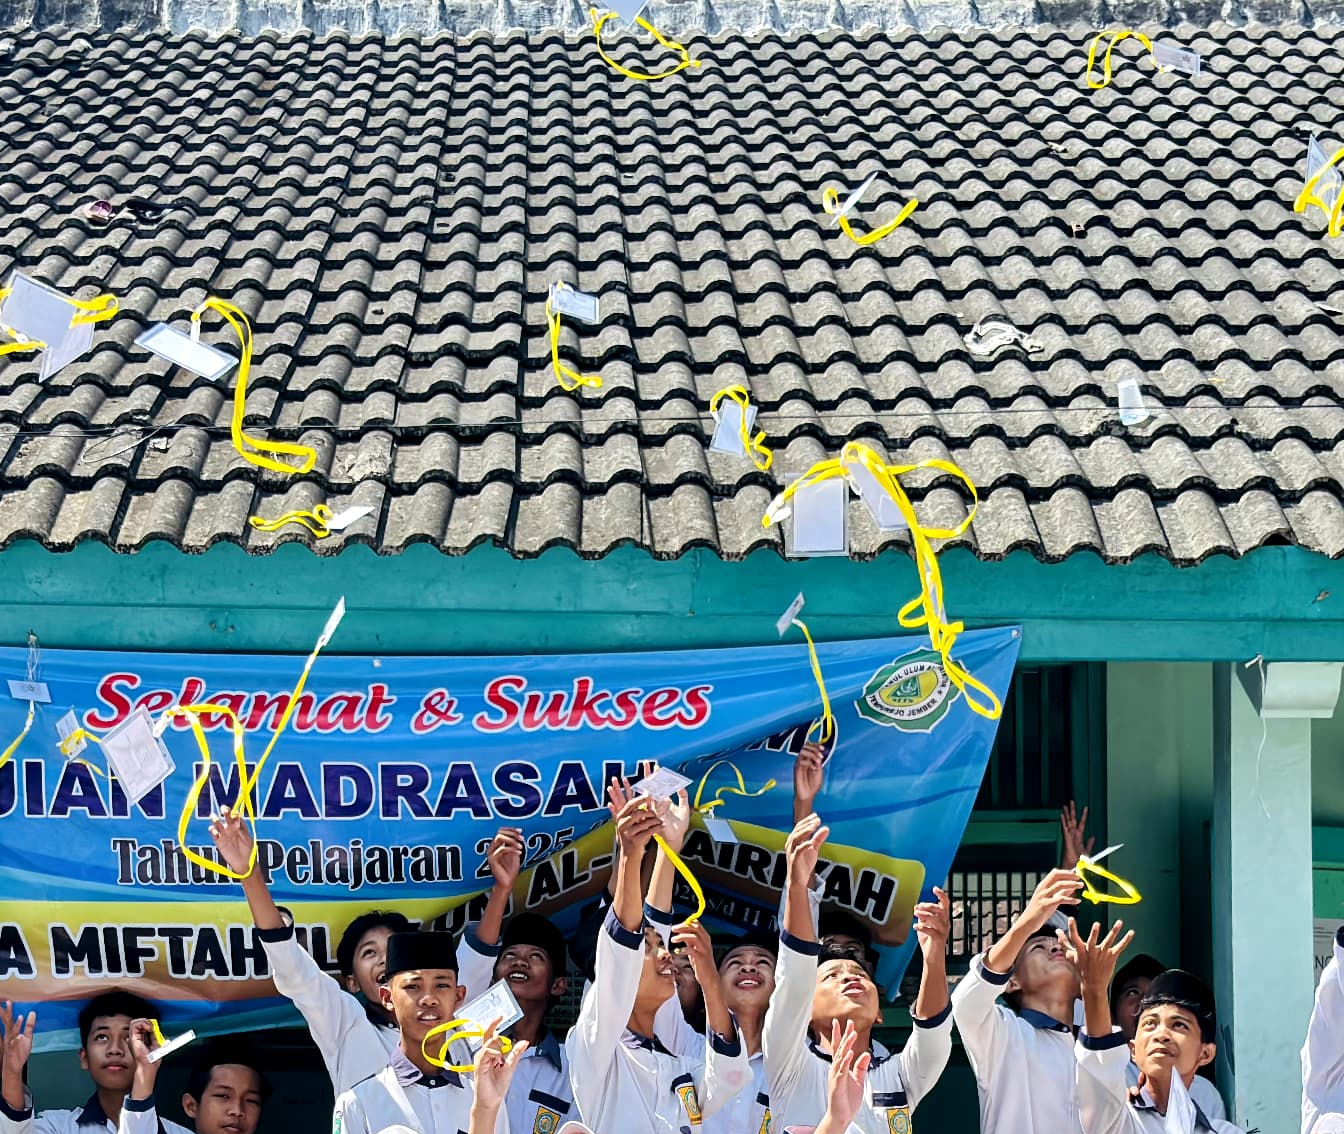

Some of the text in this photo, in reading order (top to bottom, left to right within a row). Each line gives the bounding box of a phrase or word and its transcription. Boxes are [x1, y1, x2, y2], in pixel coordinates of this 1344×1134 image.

[85, 673, 713, 732] Selamat & Sukses
[907, 698, 937, 716] JEMBER
[256, 837, 463, 890] Pelajaran
[475, 826, 575, 879] 225
[48, 923, 344, 980] MIFTAHL
